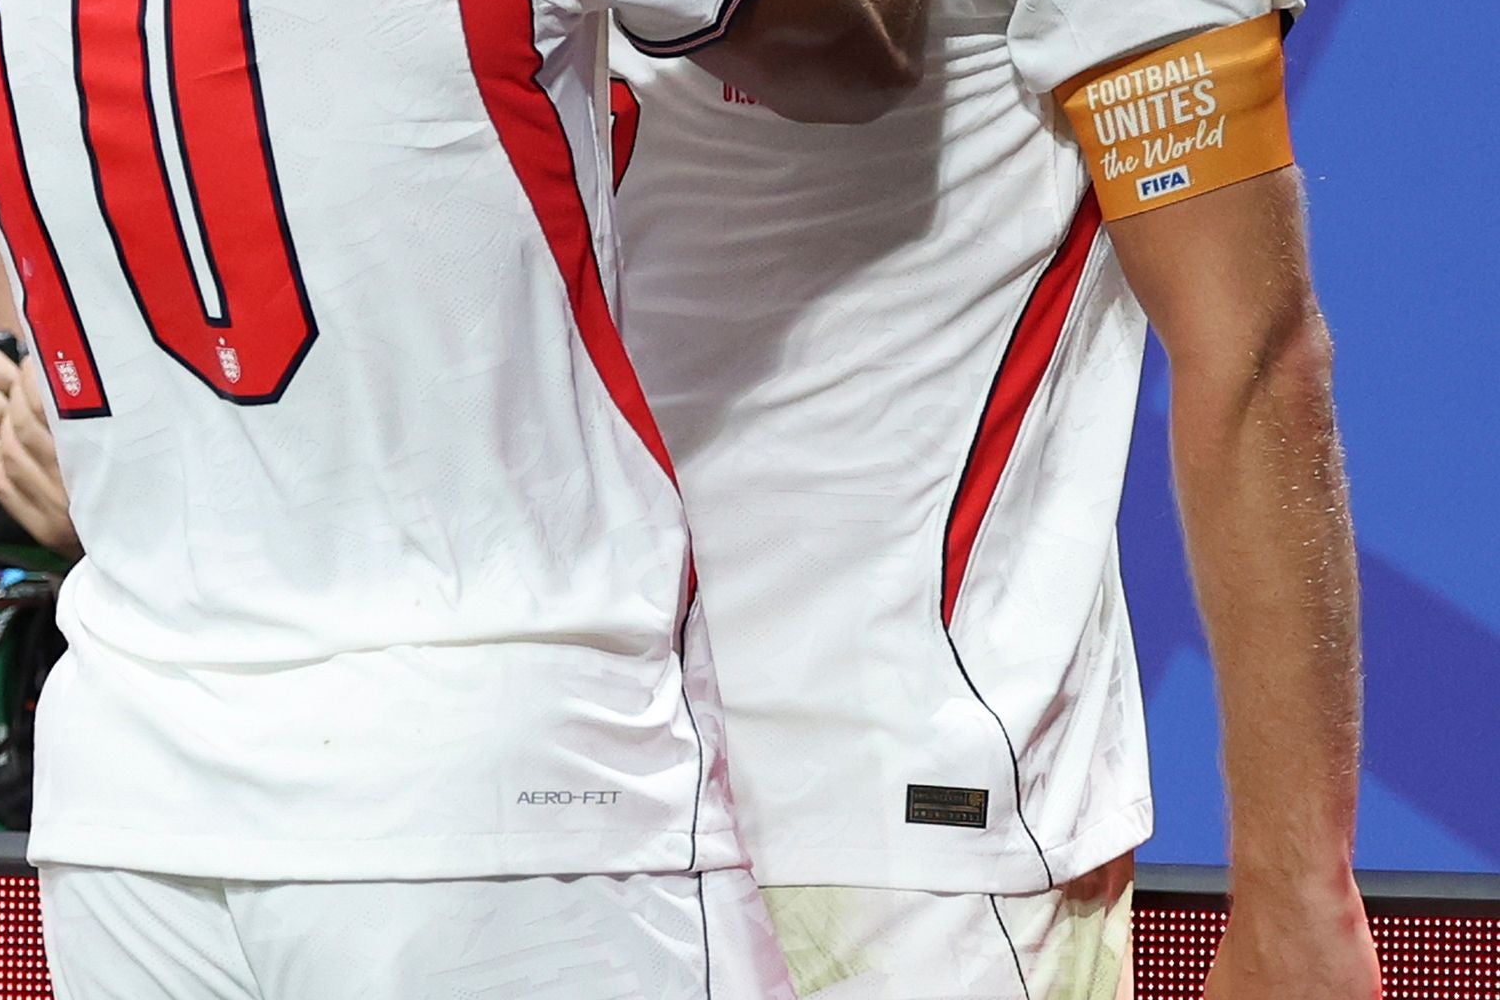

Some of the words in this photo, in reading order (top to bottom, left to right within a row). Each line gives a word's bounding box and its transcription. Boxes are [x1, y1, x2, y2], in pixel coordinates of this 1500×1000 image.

[1086, 51, 1213, 111] FOOTBALL
[1092, 78, 1217, 147] UNITES
[1100, 147, 1139, 181] the
[1141, 115, 1226, 169] World
[1140, 170, 1187, 197] FIFA
[516, 791, 622, 805] AERO-FIT
